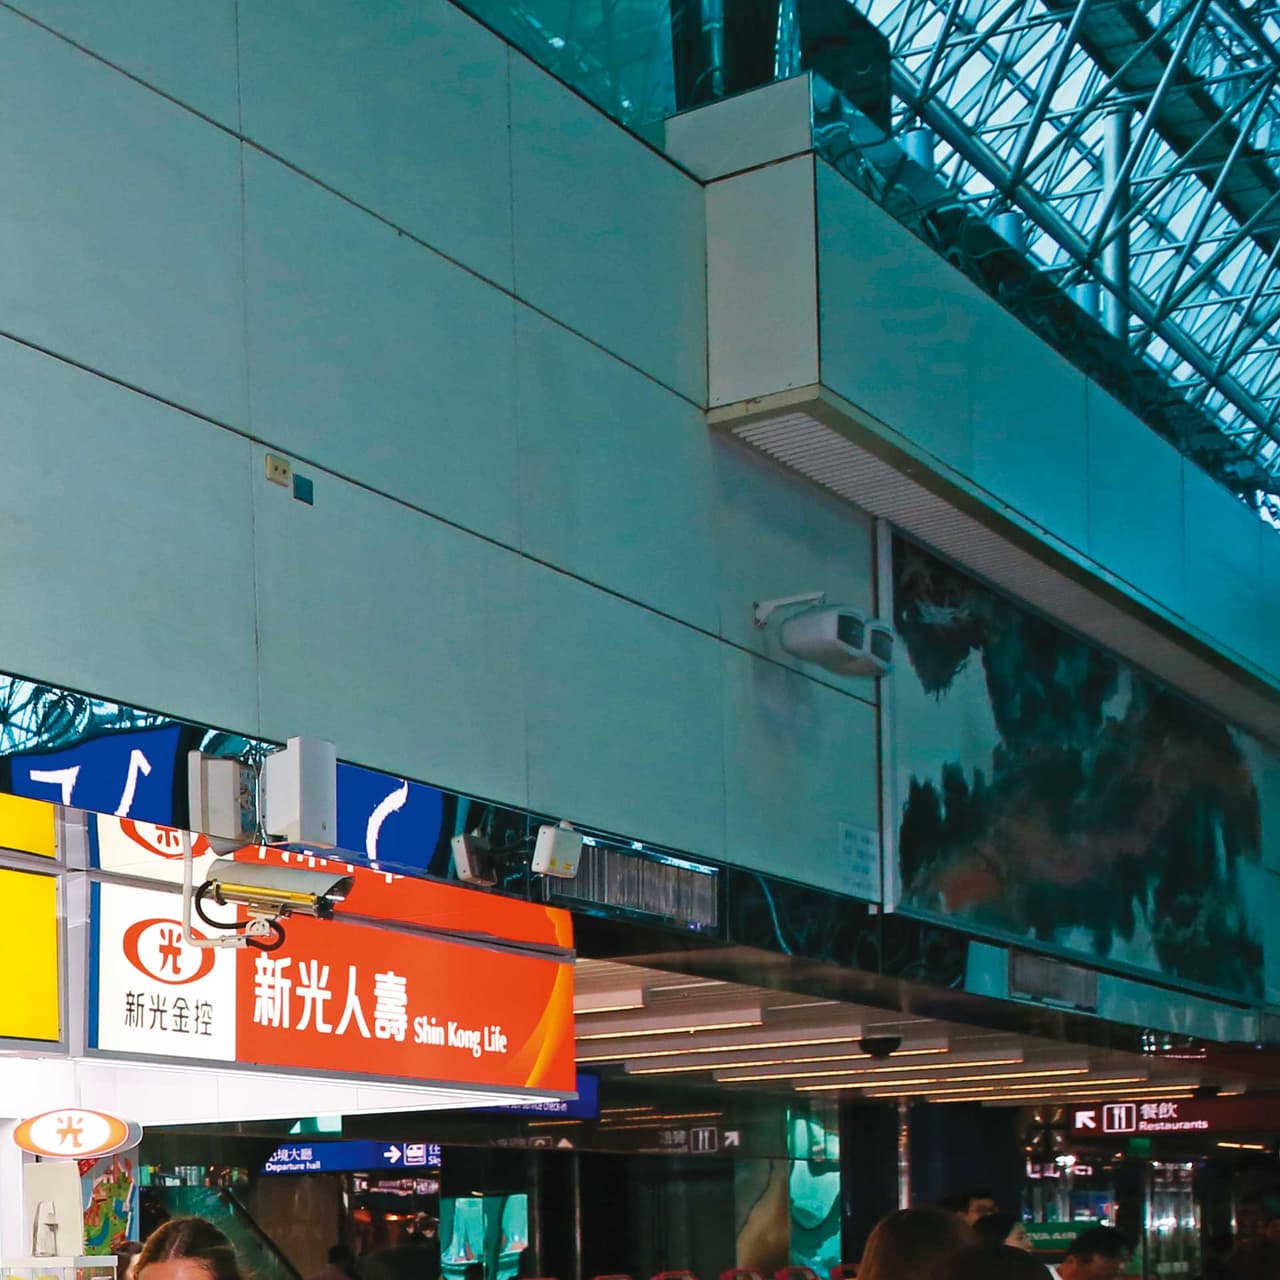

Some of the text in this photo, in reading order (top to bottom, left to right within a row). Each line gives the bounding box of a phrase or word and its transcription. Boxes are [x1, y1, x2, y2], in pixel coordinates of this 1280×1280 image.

[253, 954, 409, 1042] 新光人壽
[124, 990, 213, 1036] 新光金控
[413, 1016, 508, 1058] Shin Kong Life
[1140, 1102, 1178, 1119] 餐飲
[1139, 1120, 1209, 1131] Restaurants
[265, 1160, 321, 1173] Departure hall
